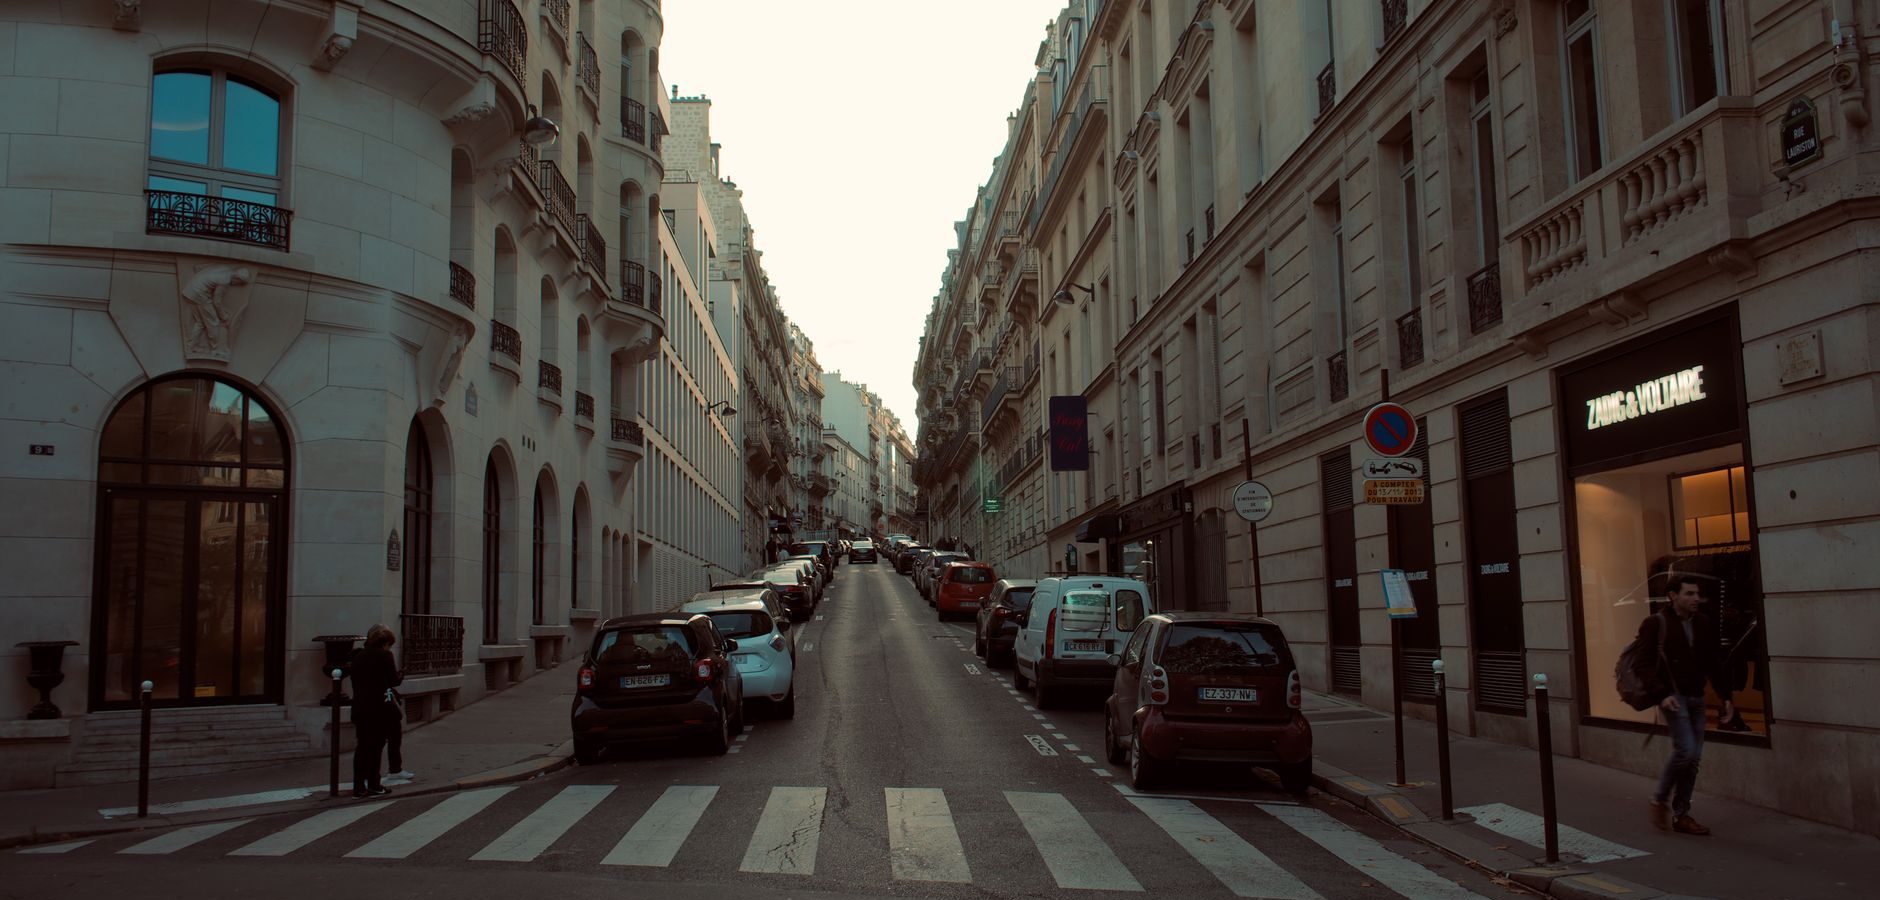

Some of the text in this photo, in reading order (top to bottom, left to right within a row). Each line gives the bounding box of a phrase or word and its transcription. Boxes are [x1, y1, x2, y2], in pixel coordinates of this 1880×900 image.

[1793, 126, 1805, 139] RUE
[1786, 137, 1816, 159] LAURISTON
[1586, 364, 1707, 430] ZADIG&VOLTAIRE
[1205, 688, 1251, 699] EZ-337-NW
